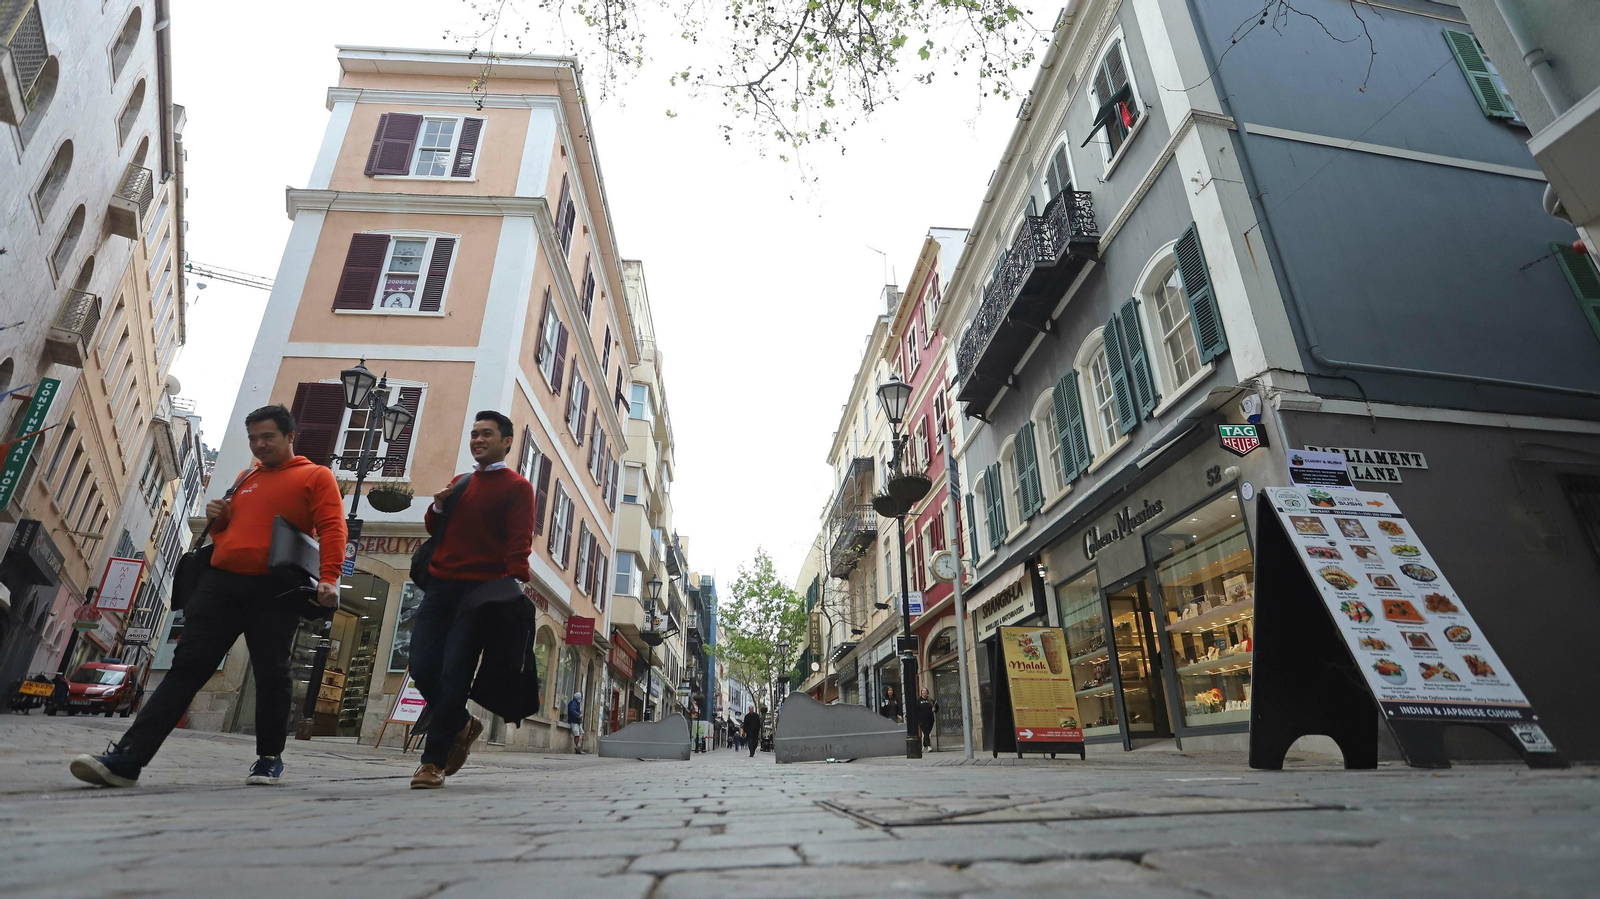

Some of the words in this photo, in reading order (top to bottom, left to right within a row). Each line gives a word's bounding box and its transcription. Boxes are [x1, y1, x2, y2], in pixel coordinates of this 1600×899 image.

[1222, 426, 1254, 436] TAG
[1223, 437, 1258, 453] HEUER
[1308, 446, 1422, 467] LIAMENT
[1206, 465, 1222, 487] 52
[1352, 466, 1398, 481] LANE
[357, 537, 422, 552] SERUYA
[109, 567, 129, 607] MATALAN
[1008, 660, 1046, 672] Malak
[1400, 706, 1432, 715] INDIAN
[1434, 707, 1442, 716] &
[1443, 708, 1486, 717] JAPANESE
[1487, 709, 1522, 719] CUISINE
